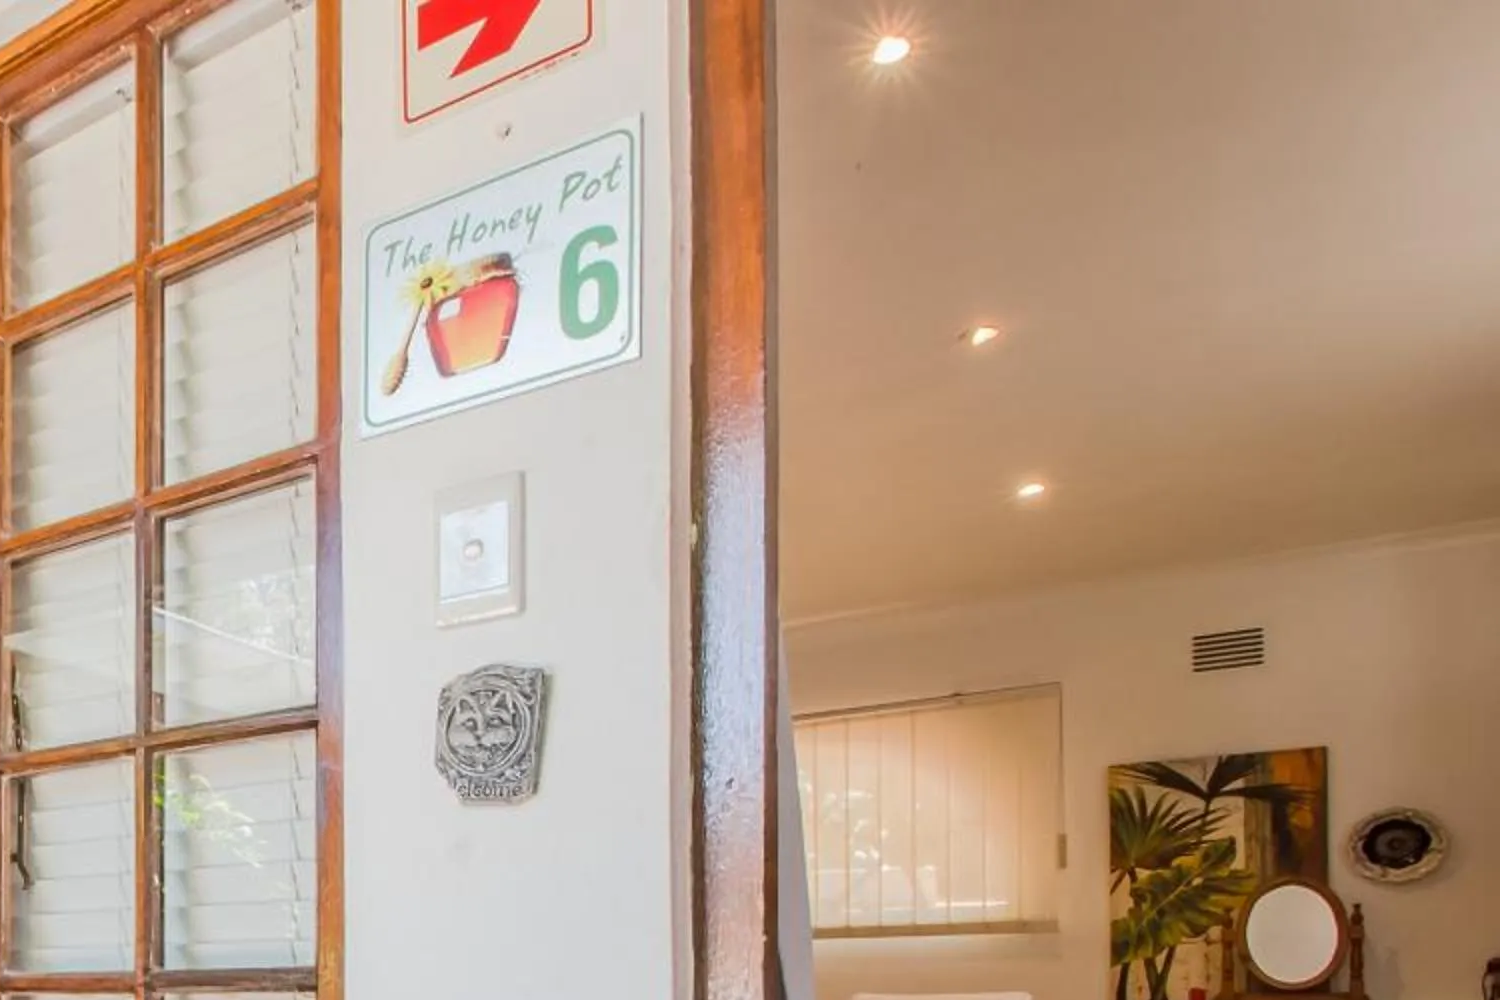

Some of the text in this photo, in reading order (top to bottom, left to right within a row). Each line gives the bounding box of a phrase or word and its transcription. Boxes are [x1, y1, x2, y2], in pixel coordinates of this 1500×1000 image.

[384, 154, 623, 277] The Honey Pot
[558, 224, 620, 341] 6
